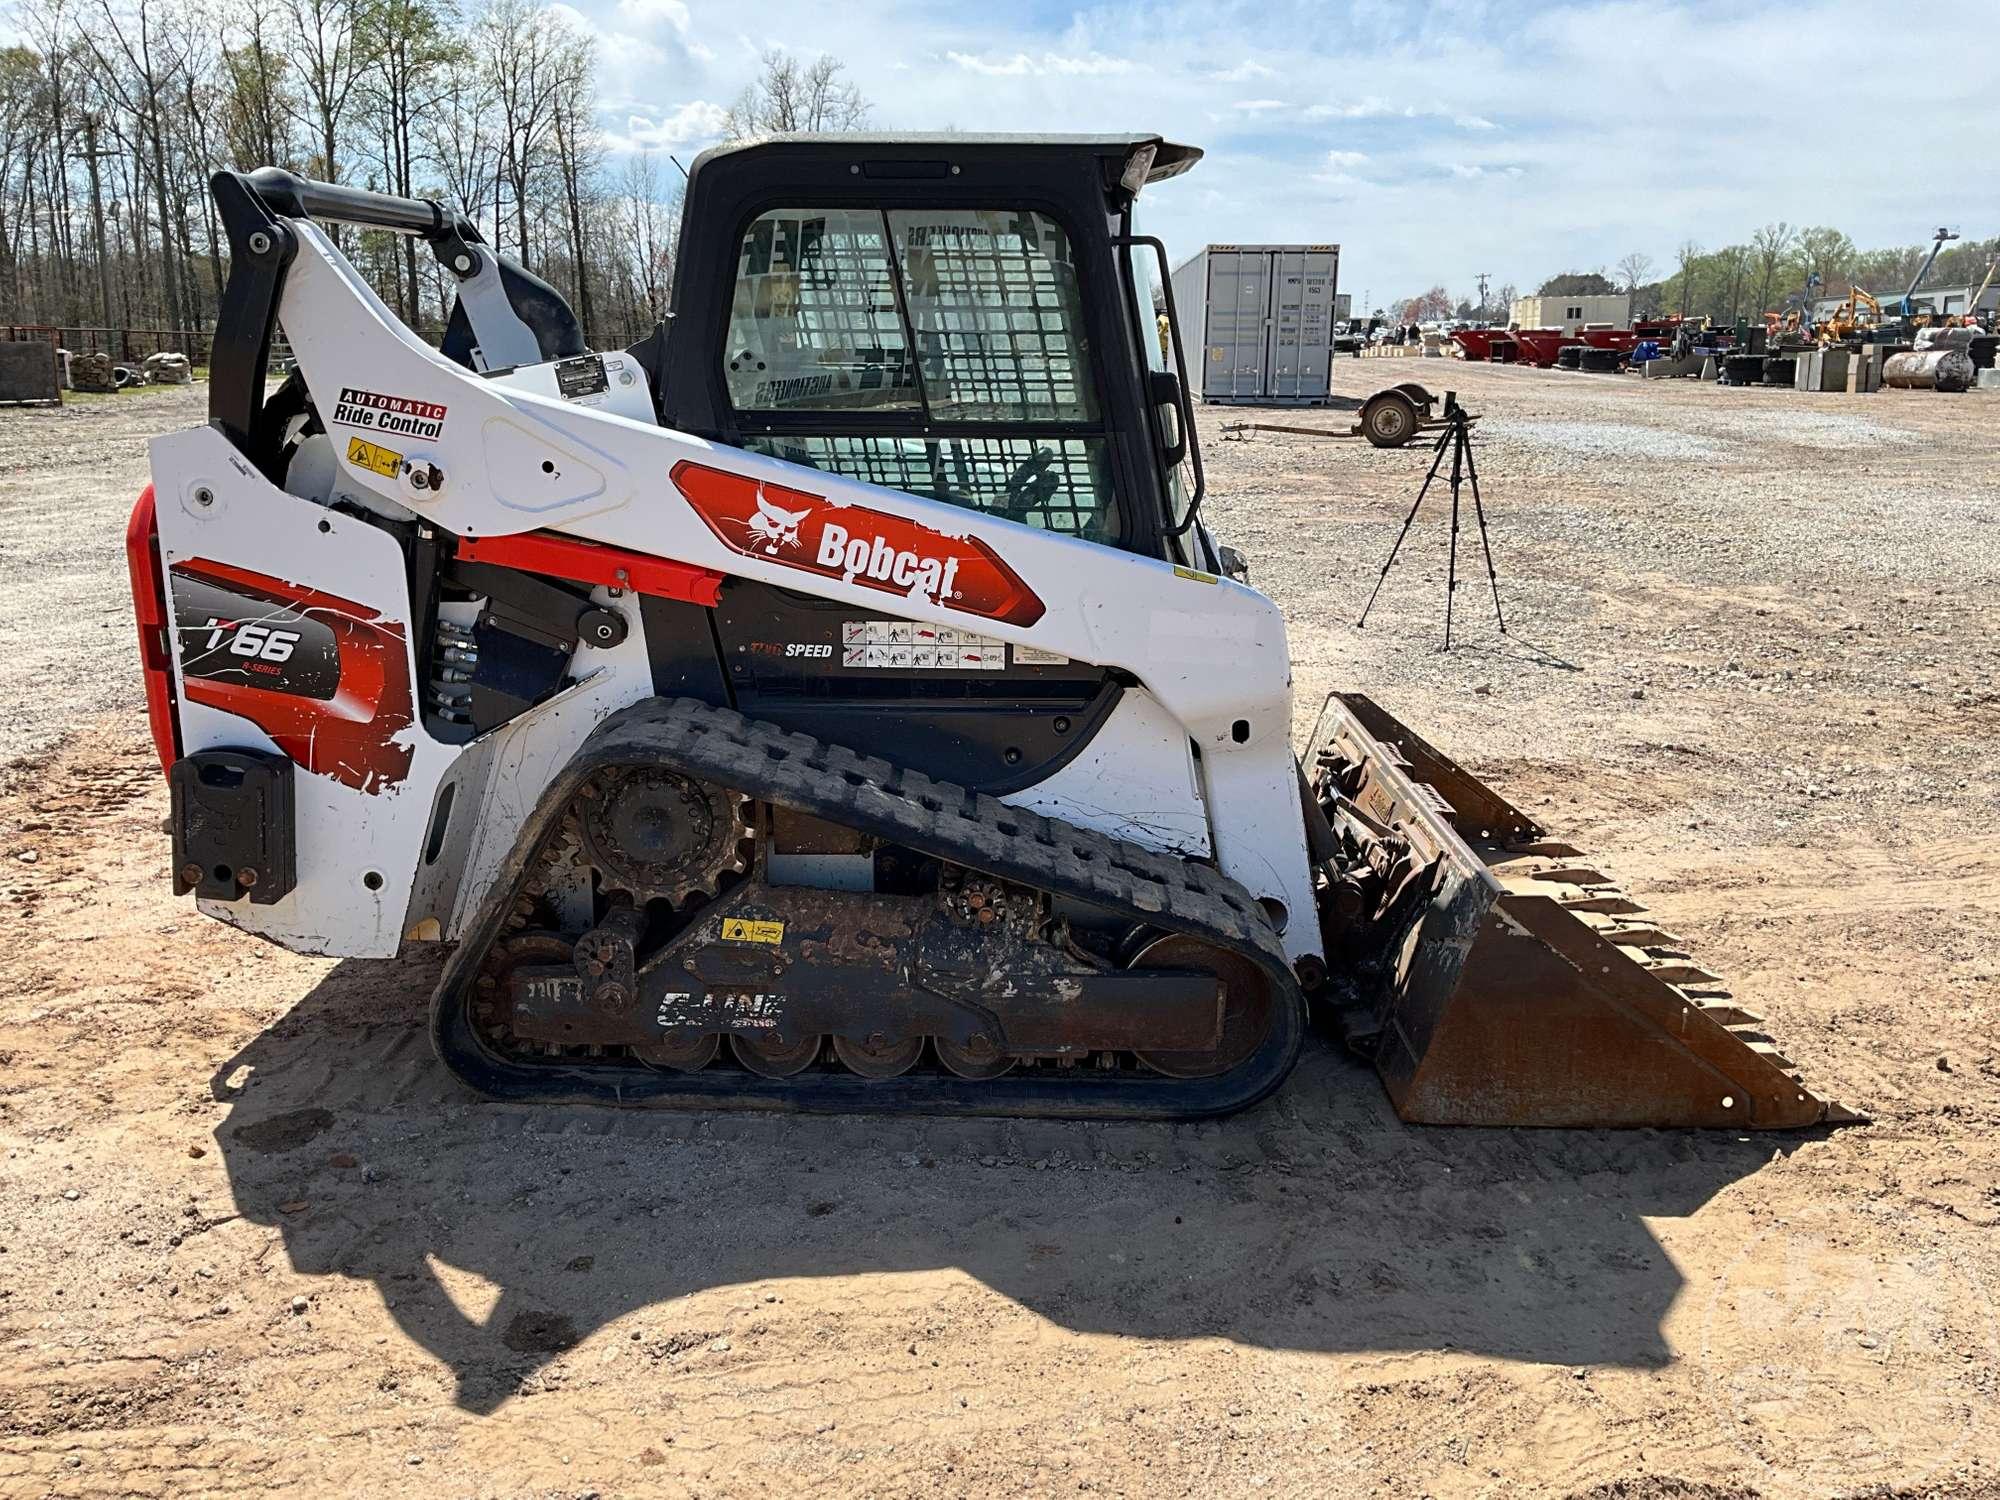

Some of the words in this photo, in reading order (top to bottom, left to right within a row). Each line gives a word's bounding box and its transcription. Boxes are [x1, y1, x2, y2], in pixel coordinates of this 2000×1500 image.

[343, 391, 443, 418] AUTOMATIC
[333, 403, 374, 426] Ride
[378, 411, 444, 438] Control
[816, 522, 960, 600] Bobcat
[785, 643, 833, 658] SPEED
[241, 661, 283, 676] R-SERIES
